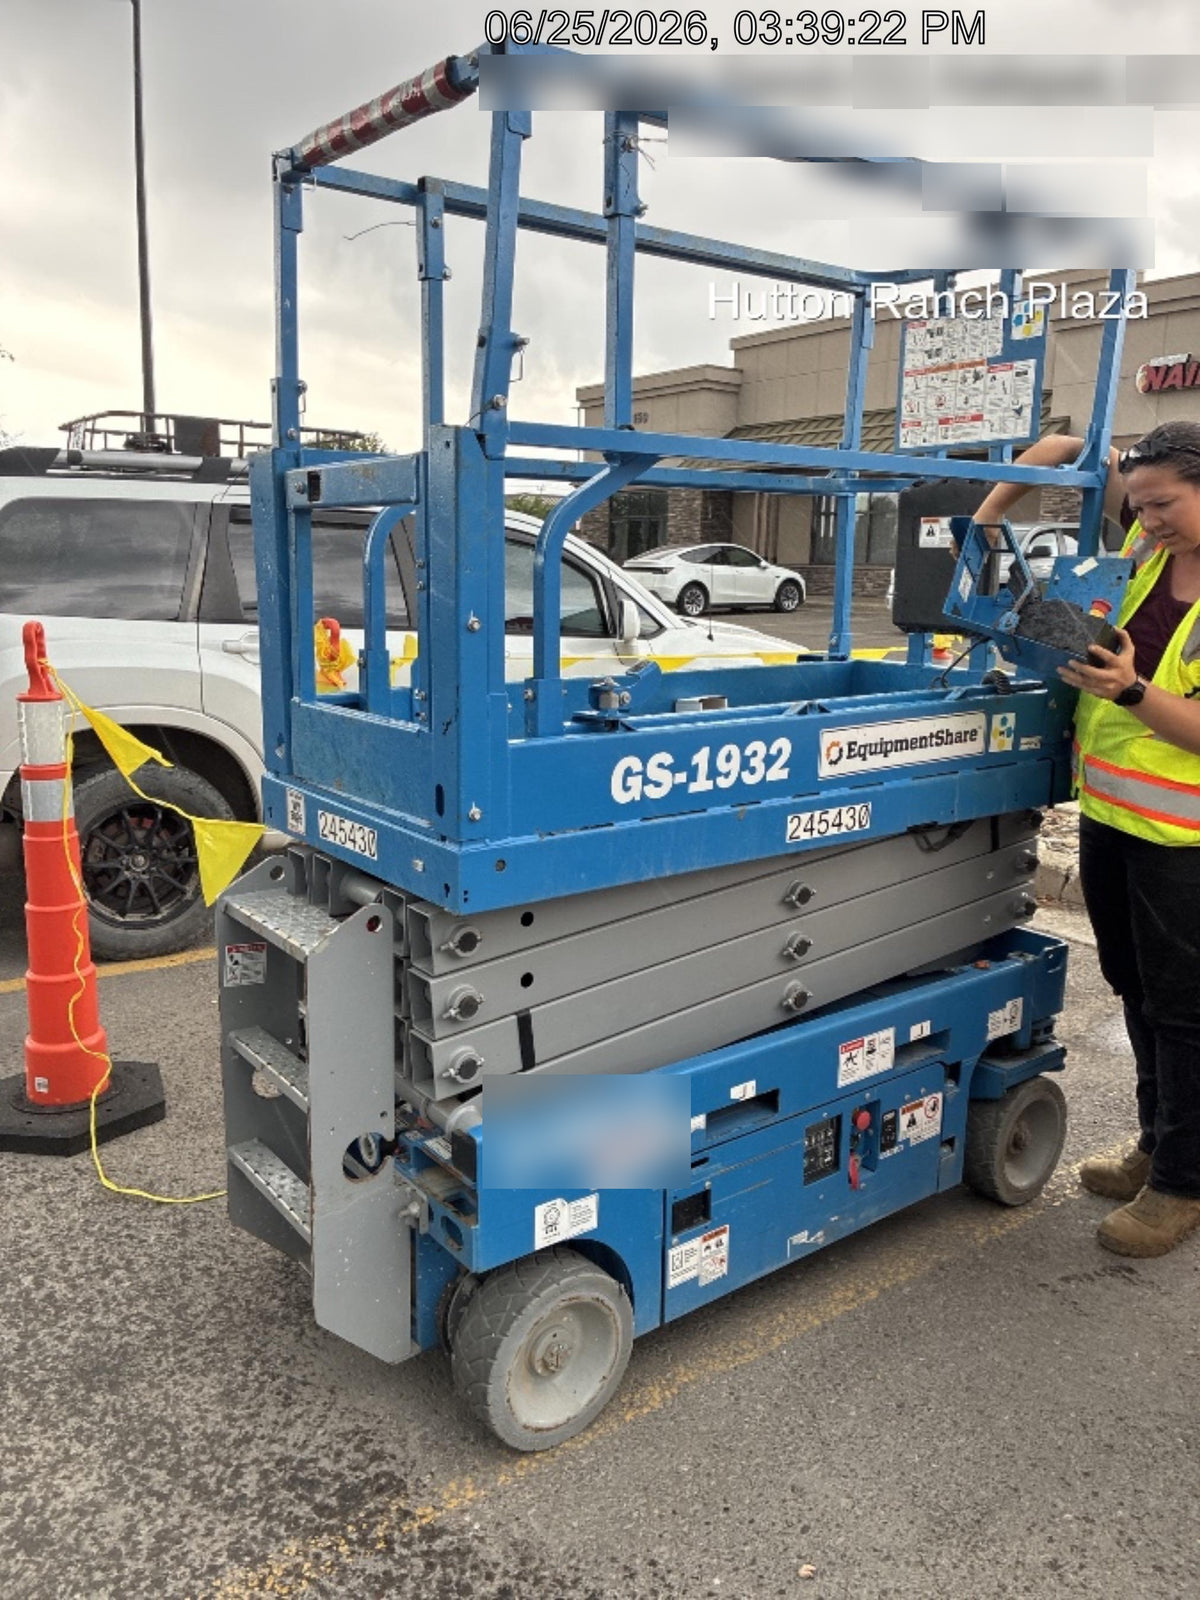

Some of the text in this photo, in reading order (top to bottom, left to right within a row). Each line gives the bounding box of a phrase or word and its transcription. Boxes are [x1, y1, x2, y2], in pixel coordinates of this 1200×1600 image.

[845, 727, 977, 761] EquipmentShare
[610, 736, 793, 805] GS-1932
[319, 811, 376, 858] 245430
[788, 804, 871, 840] 245430
